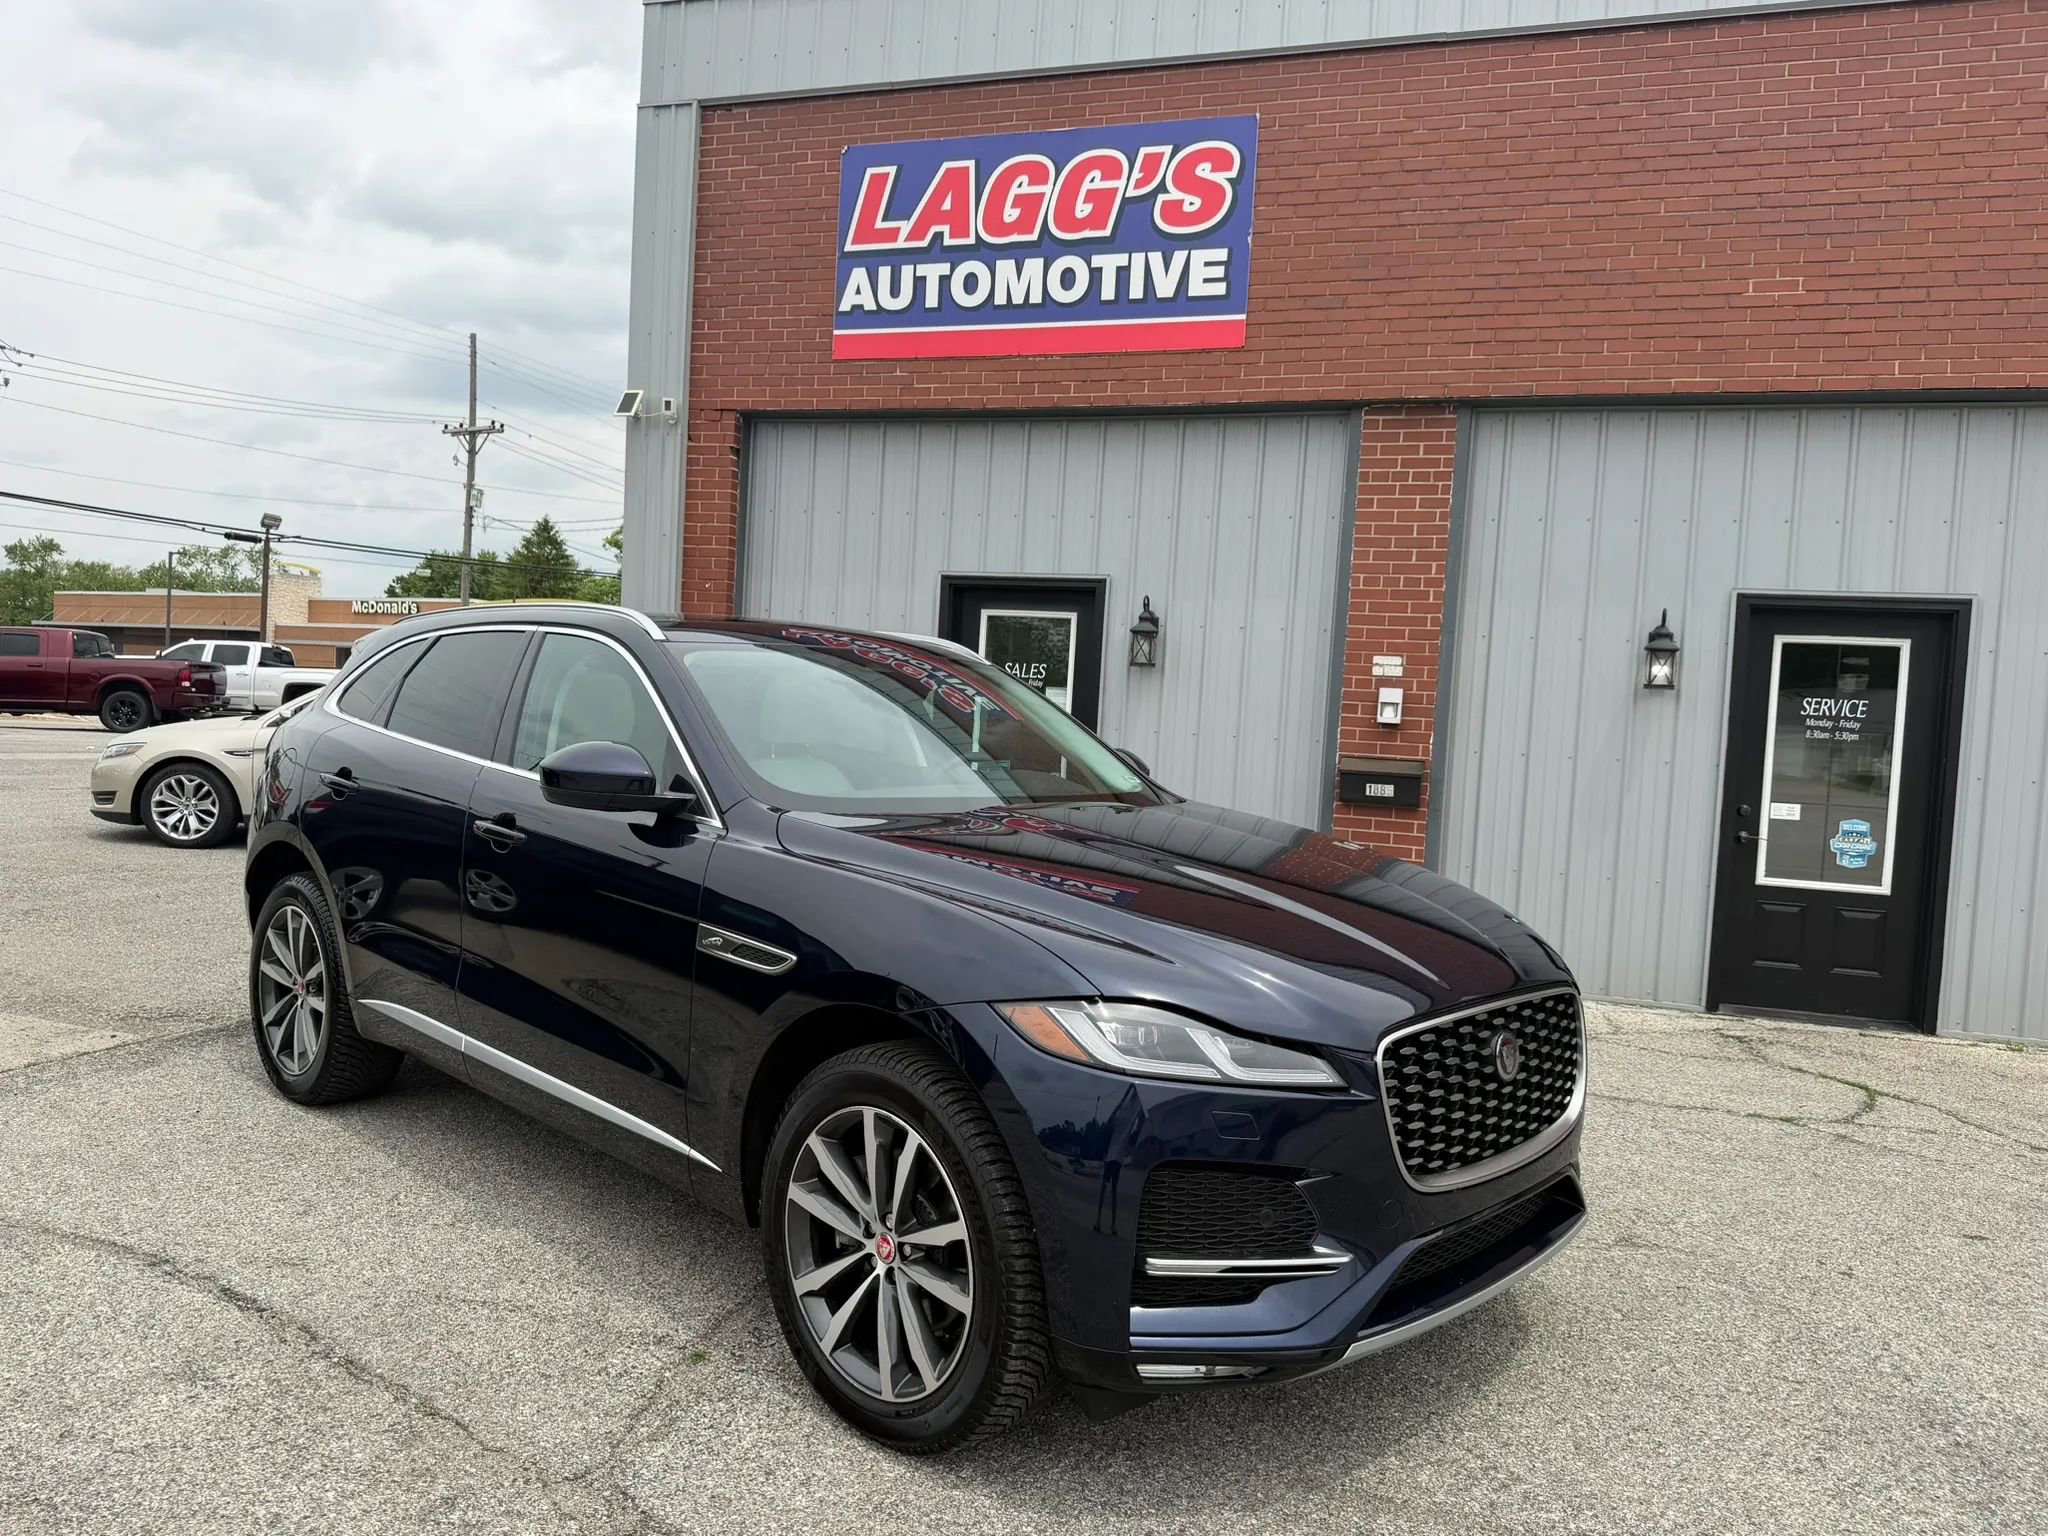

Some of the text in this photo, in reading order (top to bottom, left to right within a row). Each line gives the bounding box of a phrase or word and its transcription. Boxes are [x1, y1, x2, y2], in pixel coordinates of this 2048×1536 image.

[844, 140, 1241, 252] LAGG'S
[838, 247, 1230, 313] AUTOMOTIVE
[351, 600, 418, 614] McDonald's
[1004, 662, 1047, 679] SALES
[1800, 697, 1869, 718] SERVICE
[1804, 718, 1834, 730] Monday
[1838, 719, 1862, 731] Friday
